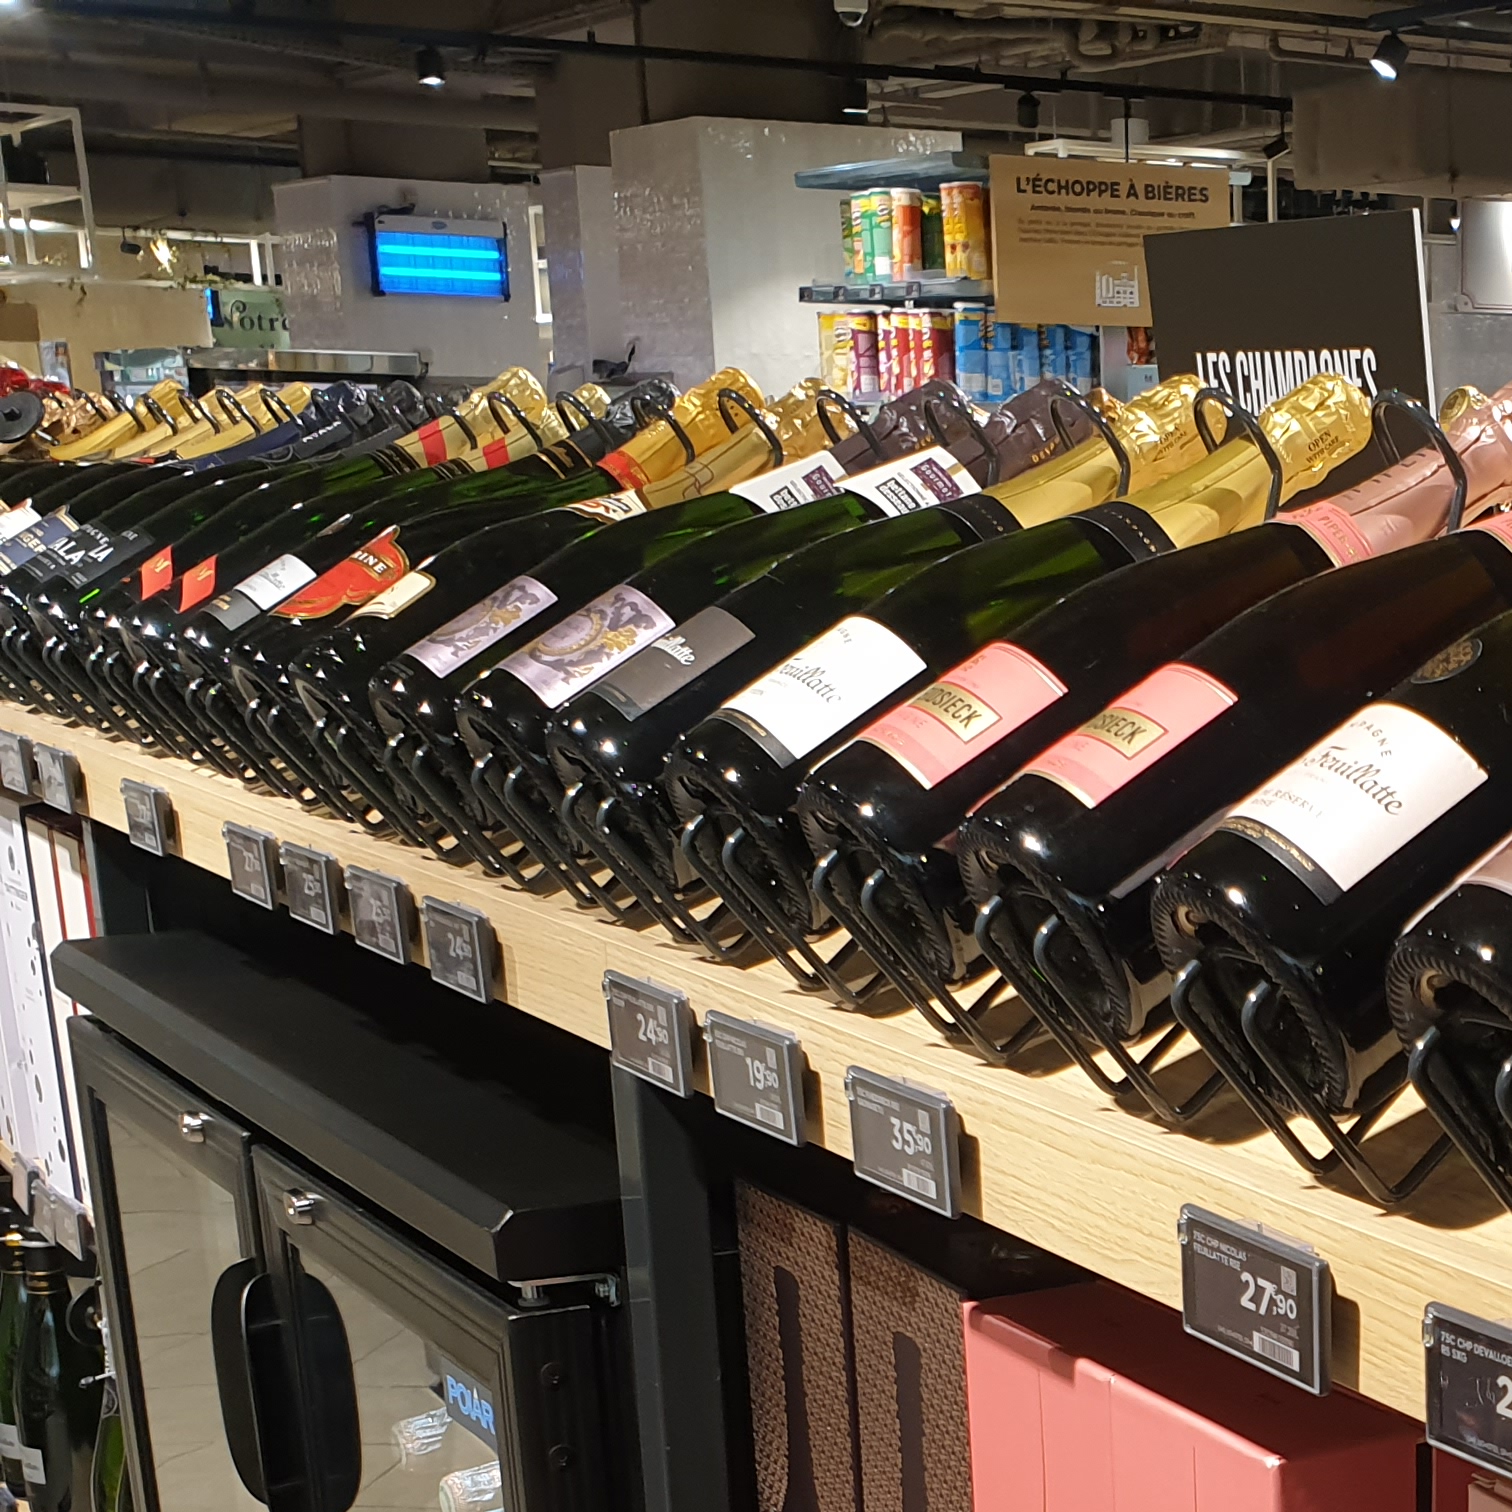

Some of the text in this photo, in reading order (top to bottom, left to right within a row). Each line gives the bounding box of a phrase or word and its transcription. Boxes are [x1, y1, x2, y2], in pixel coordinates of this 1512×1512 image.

[1015, 173, 1210, 204] L'ÉCHOPPE À BIÈRES
[1235, 347, 1378, 417] CHAMES
[1307, 429, 1333, 453] OPEN
[1317, 745, 1403, 816] Feuillatte
[446, 1374, 496, 1436] POLAR
